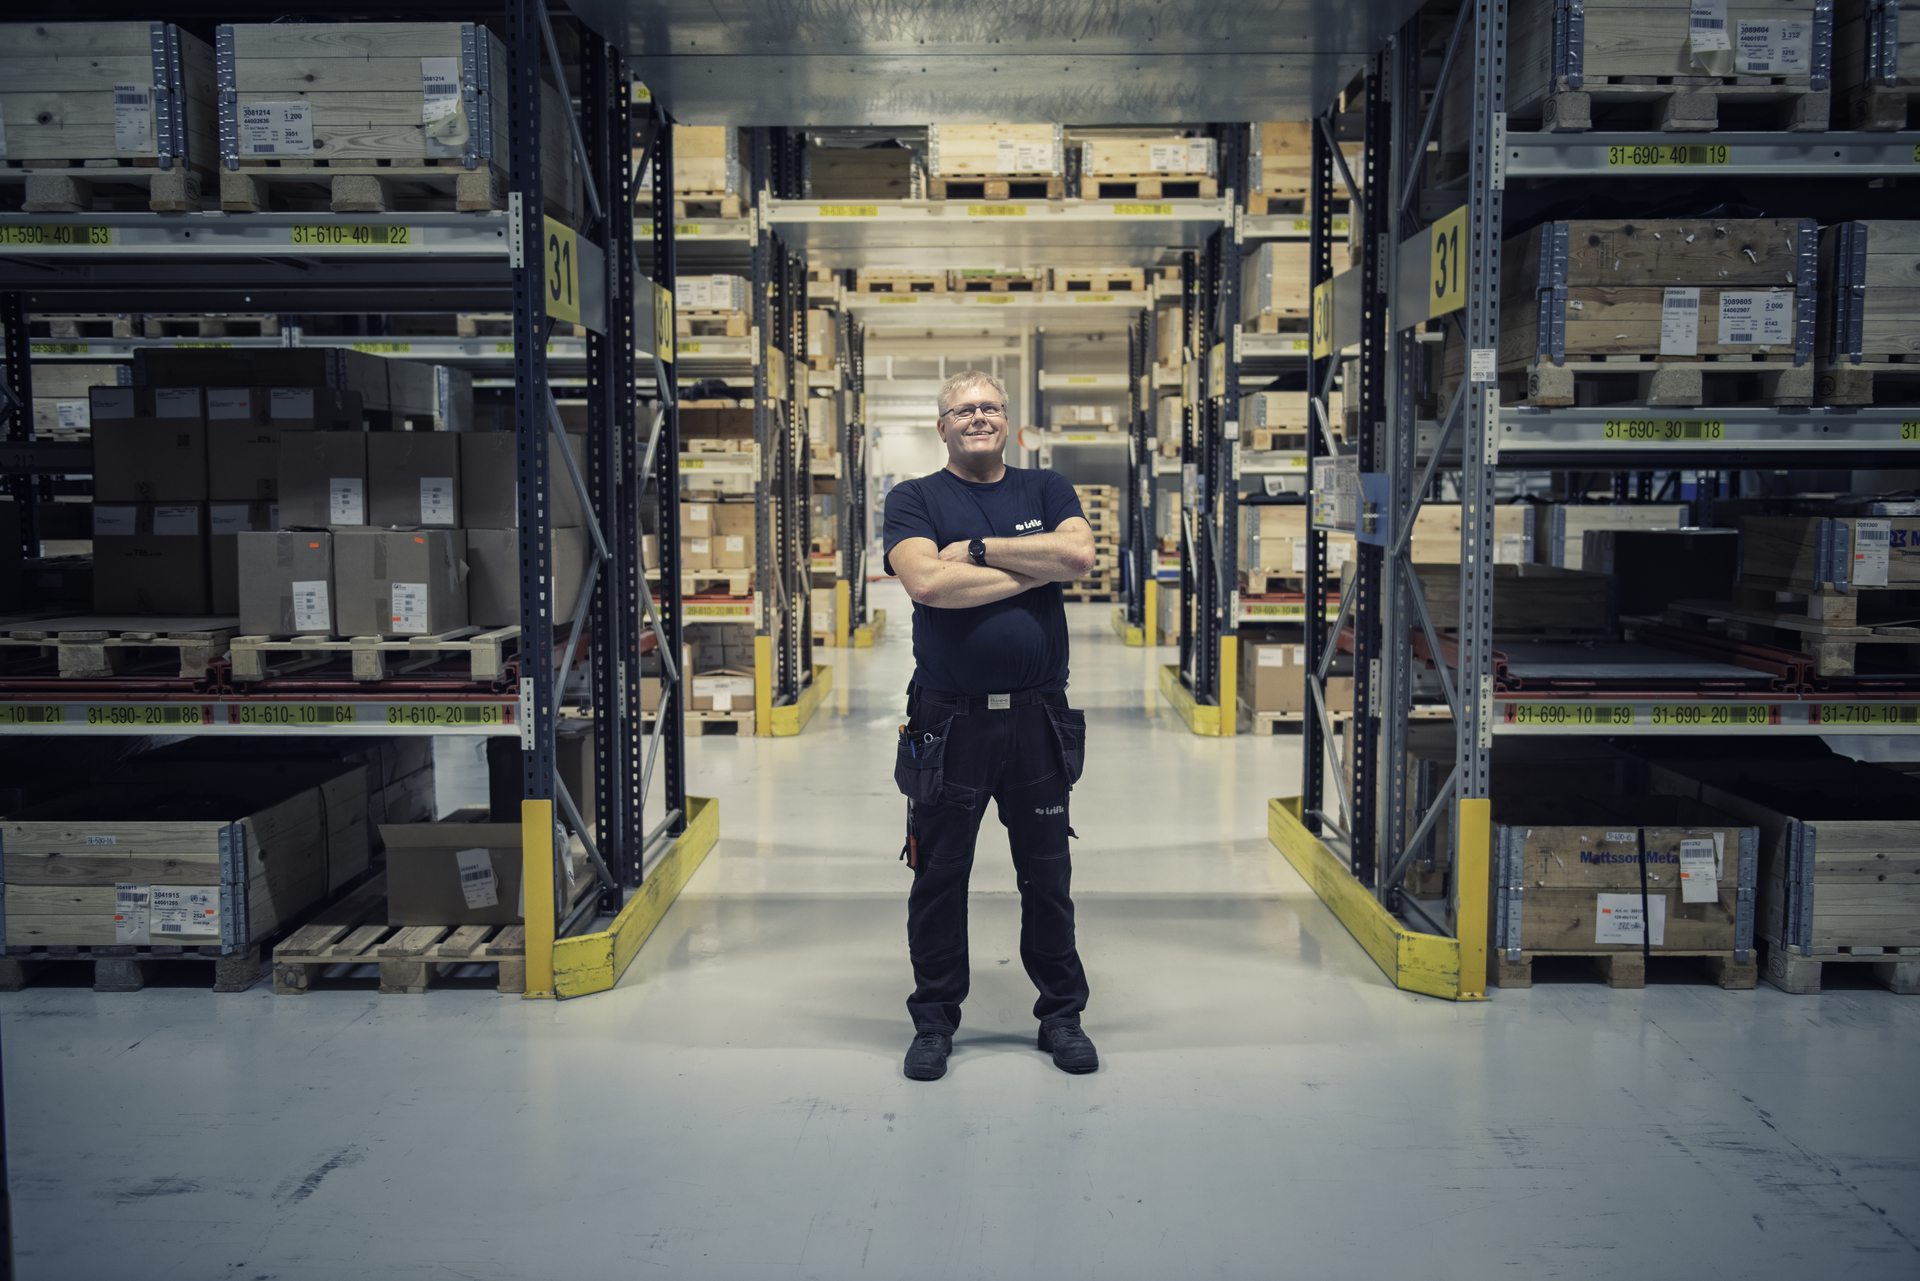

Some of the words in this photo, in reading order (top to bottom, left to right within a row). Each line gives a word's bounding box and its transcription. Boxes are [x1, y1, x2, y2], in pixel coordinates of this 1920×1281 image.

[1609, 146, 1665, 164] 31-690-
[1670, 146, 1687, 164] 40
[1709, 146, 1726, 164] 19
[54, 226, 70, 244] 40
[92, 226, 108, 244] 53
[294, 226, 348, 243] 31-610-
[353, 226, 369, 243] 40
[390, 226, 407, 243] 22
[550, 233, 572, 306] 31
[1435, 225, 1458, 298] 31
[659, 296, 670, 348] 30
[1316, 293, 1330, 345] 30
[1605, 421, 1660, 438] 31-690-
[1664, 421, 1682, 438] 30
[1704, 421, 1720, 438] 18
[9, 706, 24, 722] 10
[46, 706, 60, 722] 21
[88, 707, 141, 724] 31-590-
[145, 707, 162, 724] 20
[183, 707, 200, 724] 86
[242, 706, 294, 723] 31-610-
[299, 706, 316, 723] 10
[335, 706, 352, 723] 64
[388, 706, 442, 723] 31-610-
[446, 706, 462, 723] 20
[483, 706, 498, 723] 51
[1517, 706, 1571, 723] 31-690-
[1576, 706, 1592, 723] 10
[1613, 706, 1630, 723] 59
[1652, 706, 1706, 723] 31-690-
[1711, 706, 1728, 723] 20
[1748, 706, 1766, 723] 30
[1822, 706, 1877, 723] 31-710-
[1882, 706, 1898, 723] 10
[1580, 852, 1641, 864] Mattsson
[1646, 852, 1679, 864] Meta
